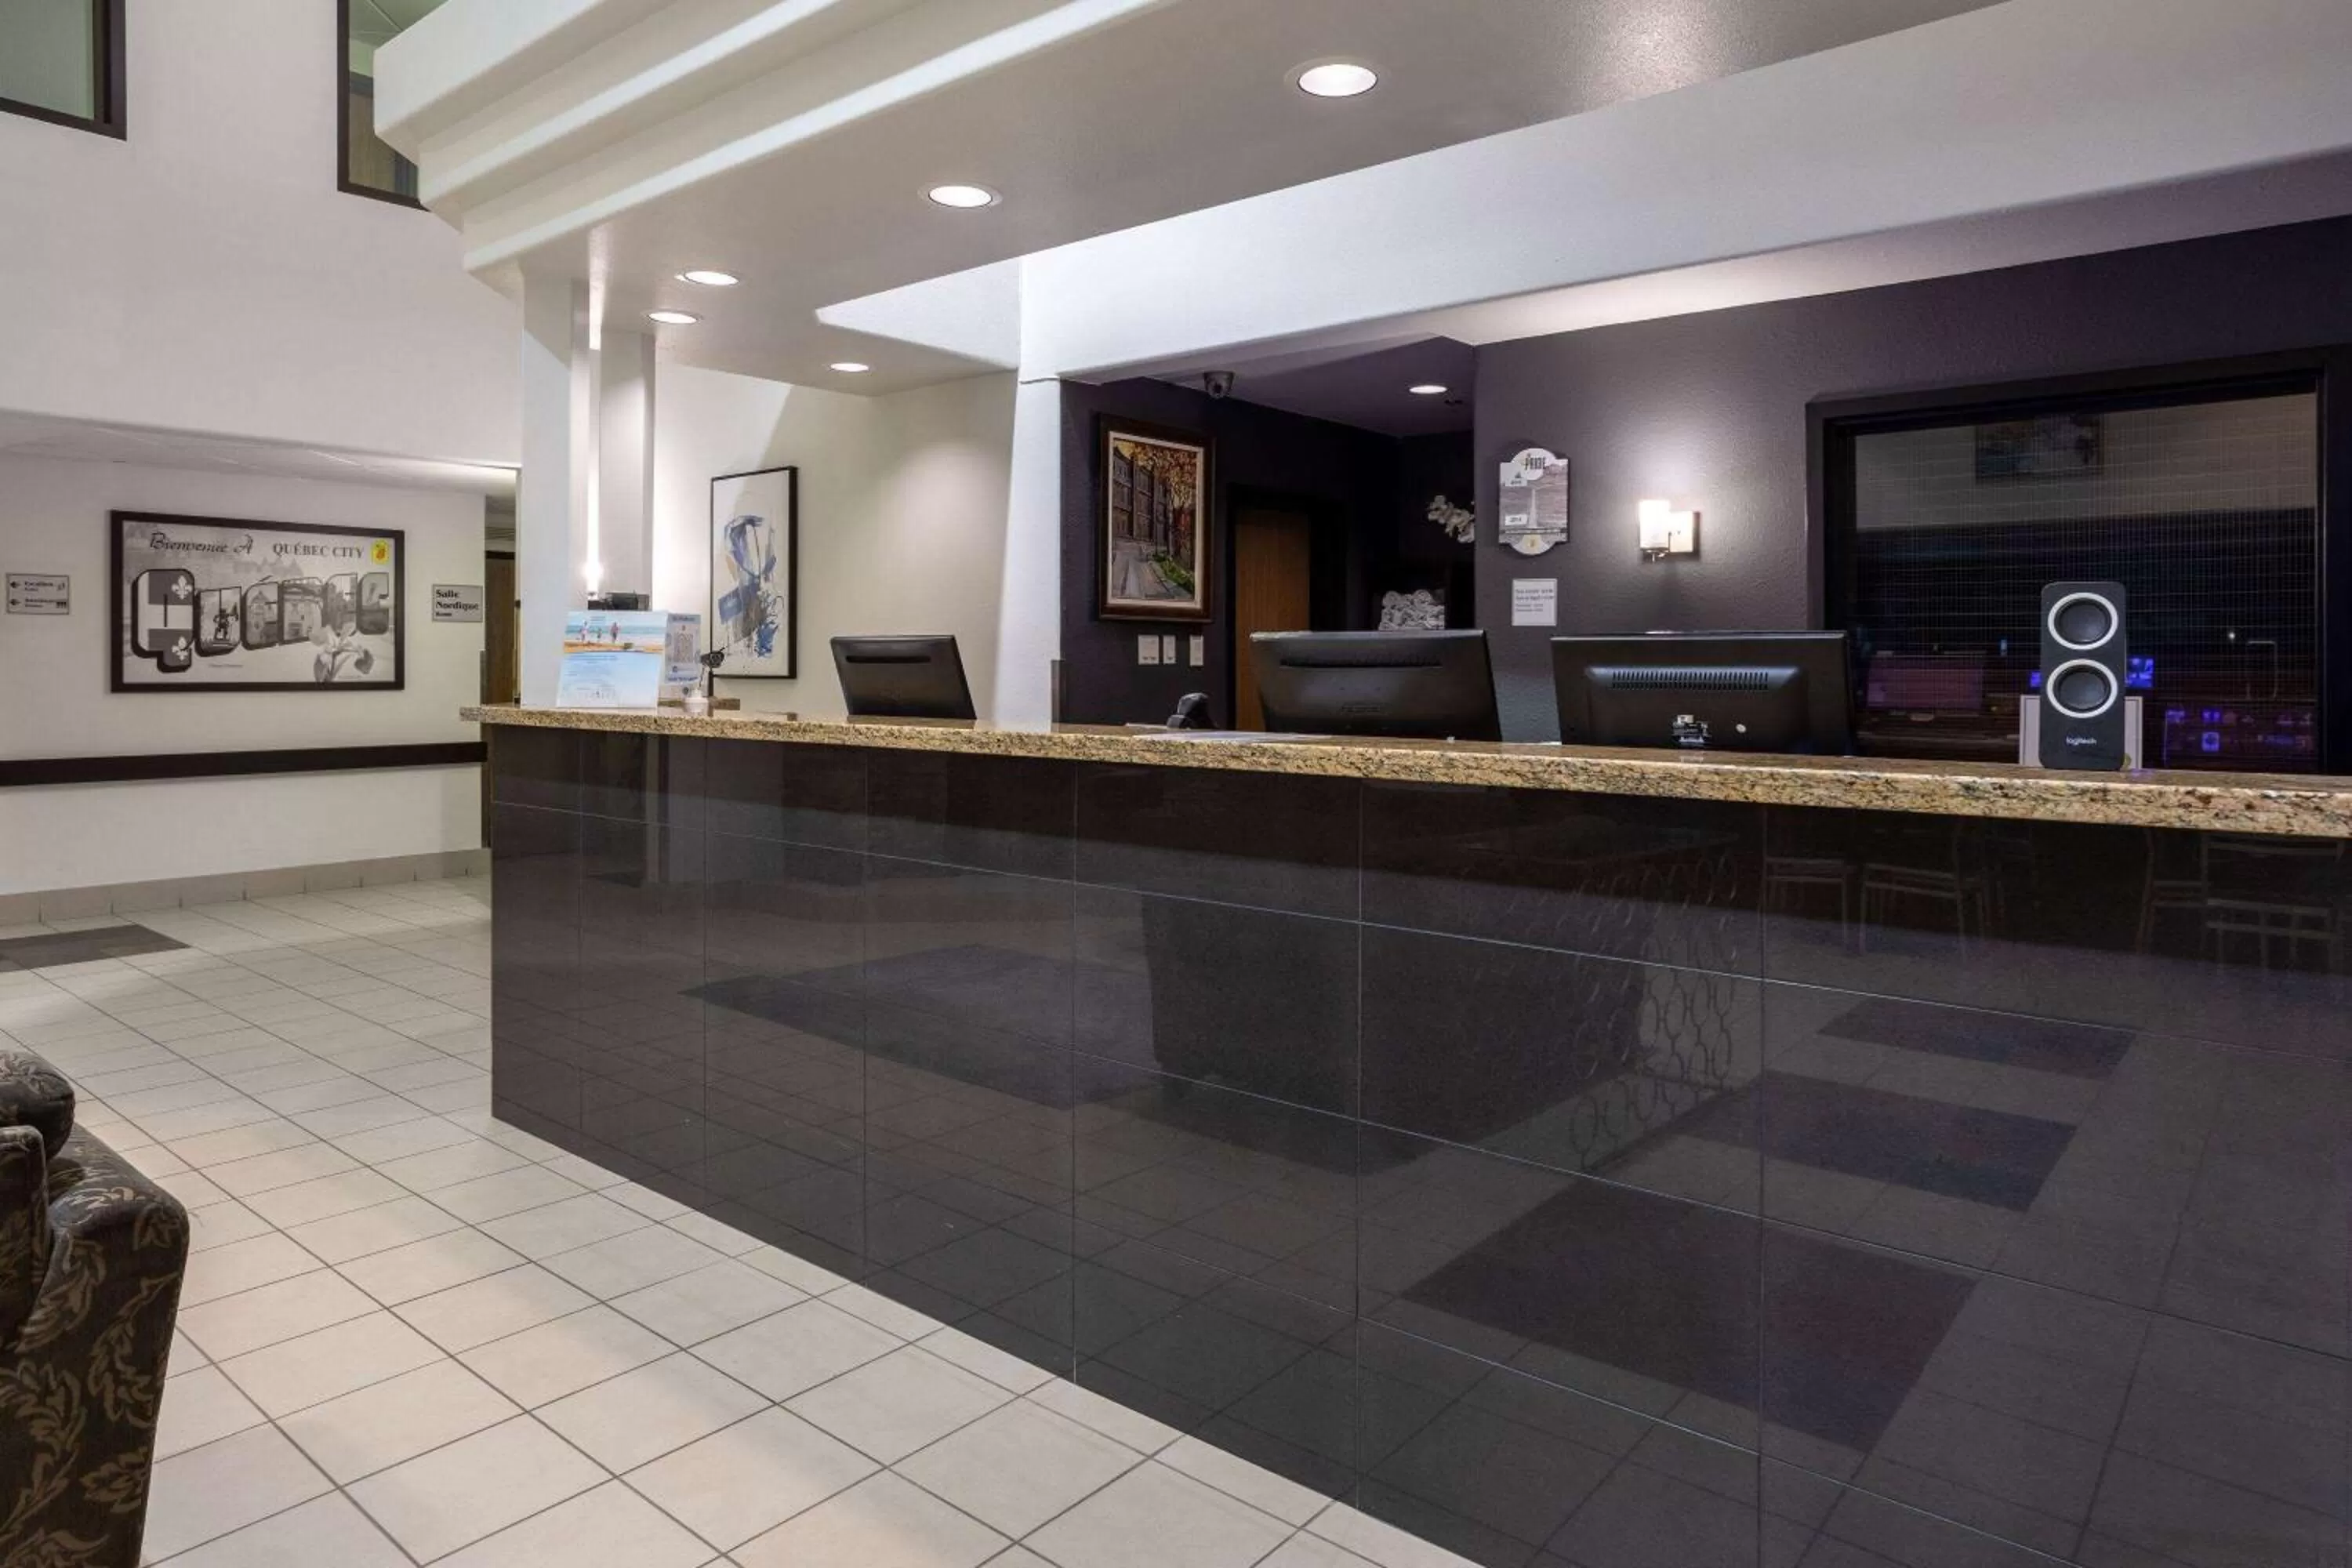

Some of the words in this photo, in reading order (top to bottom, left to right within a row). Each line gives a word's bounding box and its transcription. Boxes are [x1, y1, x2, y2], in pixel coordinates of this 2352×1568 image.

[273, 540, 328, 557] QUÉBEC
[332, 546, 364, 558] CITY
[436, 601, 479, 612] Nordique
[2066, 736, 2097, 746] logitech
